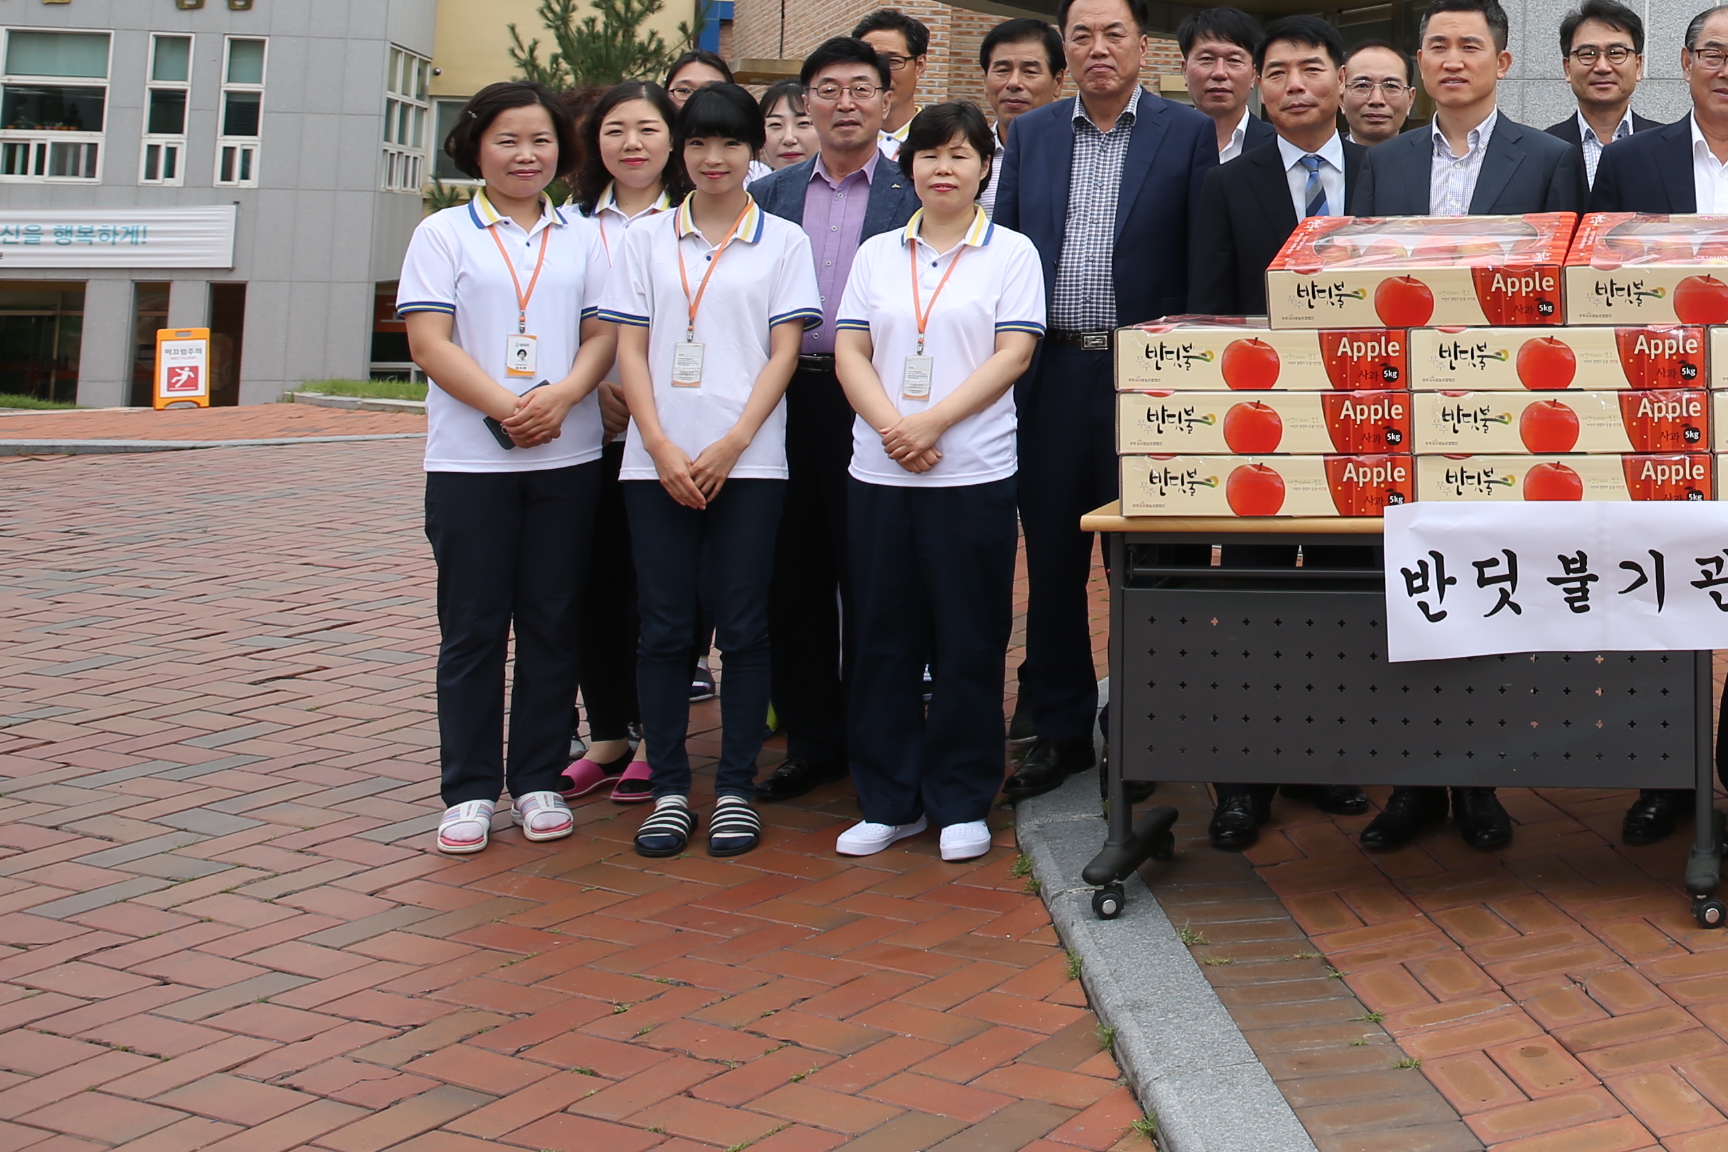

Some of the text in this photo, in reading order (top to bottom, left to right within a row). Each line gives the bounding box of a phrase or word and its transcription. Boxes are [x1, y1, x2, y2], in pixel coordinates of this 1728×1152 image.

[53, 224, 148, 246] 행복하게!
[1296, 279, 1350, 310] 반딧불
[1491, 271, 1554, 296] Apple
[1595, 278, 1649, 308] 반딧불
[1538, 305, 1552, 314] 5kg
[1145, 341, 1197, 371] 반딧불
[1337, 336, 1400, 361] Apple
[1439, 340, 1492, 371] 반딧불
[1634, 333, 1698, 359] Apple
[1384, 370, 1398, 379] 5kg
[1681, 367, 1696, 377] 5kg
[1147, 405, 1199, 434] 반딧불
[1340, 399, 1403, 424] Apple
[1442, 404, 1495, 434] 반딧불
[1637, 396, 1702, 422] Apple
[1386, 432, 1400, 442] 5kg
[1685, 430, 1699, 440] 5kg
[1149, 467, 1202, 497] 반딧불
[1343, 462, 1406, 486] Apple
[1445, 466, 1499, 496] 반딧불
[1641, 459, 1704, 484] Apple
[1389, 495, 1403, 504] 5kg
